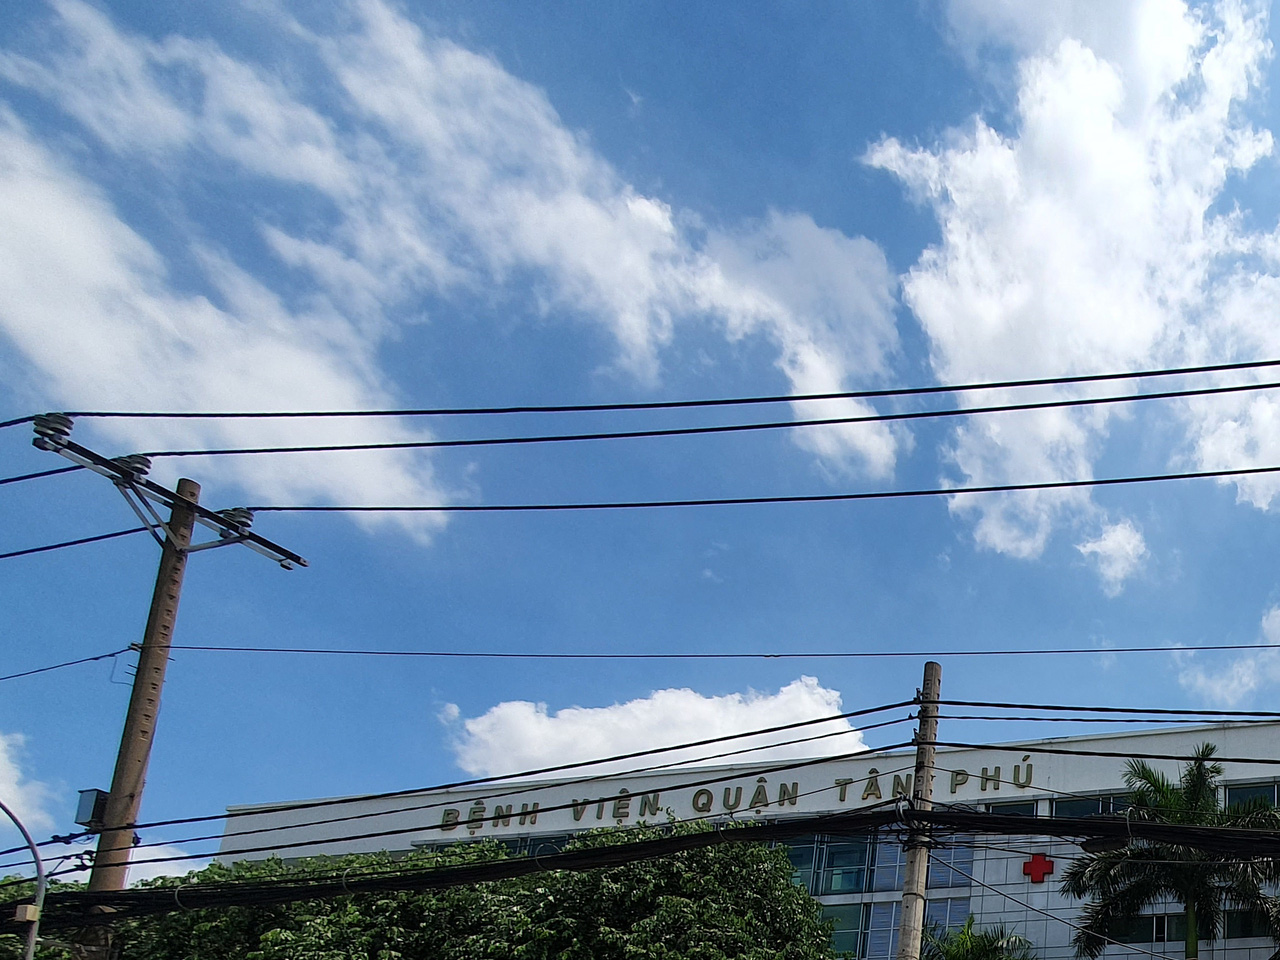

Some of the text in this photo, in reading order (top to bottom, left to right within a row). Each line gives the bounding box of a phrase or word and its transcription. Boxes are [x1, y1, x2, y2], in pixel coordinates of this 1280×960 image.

[440, 755, 1033, 835] BỆNH VIỆN QUẬN TÂN PHÚ
